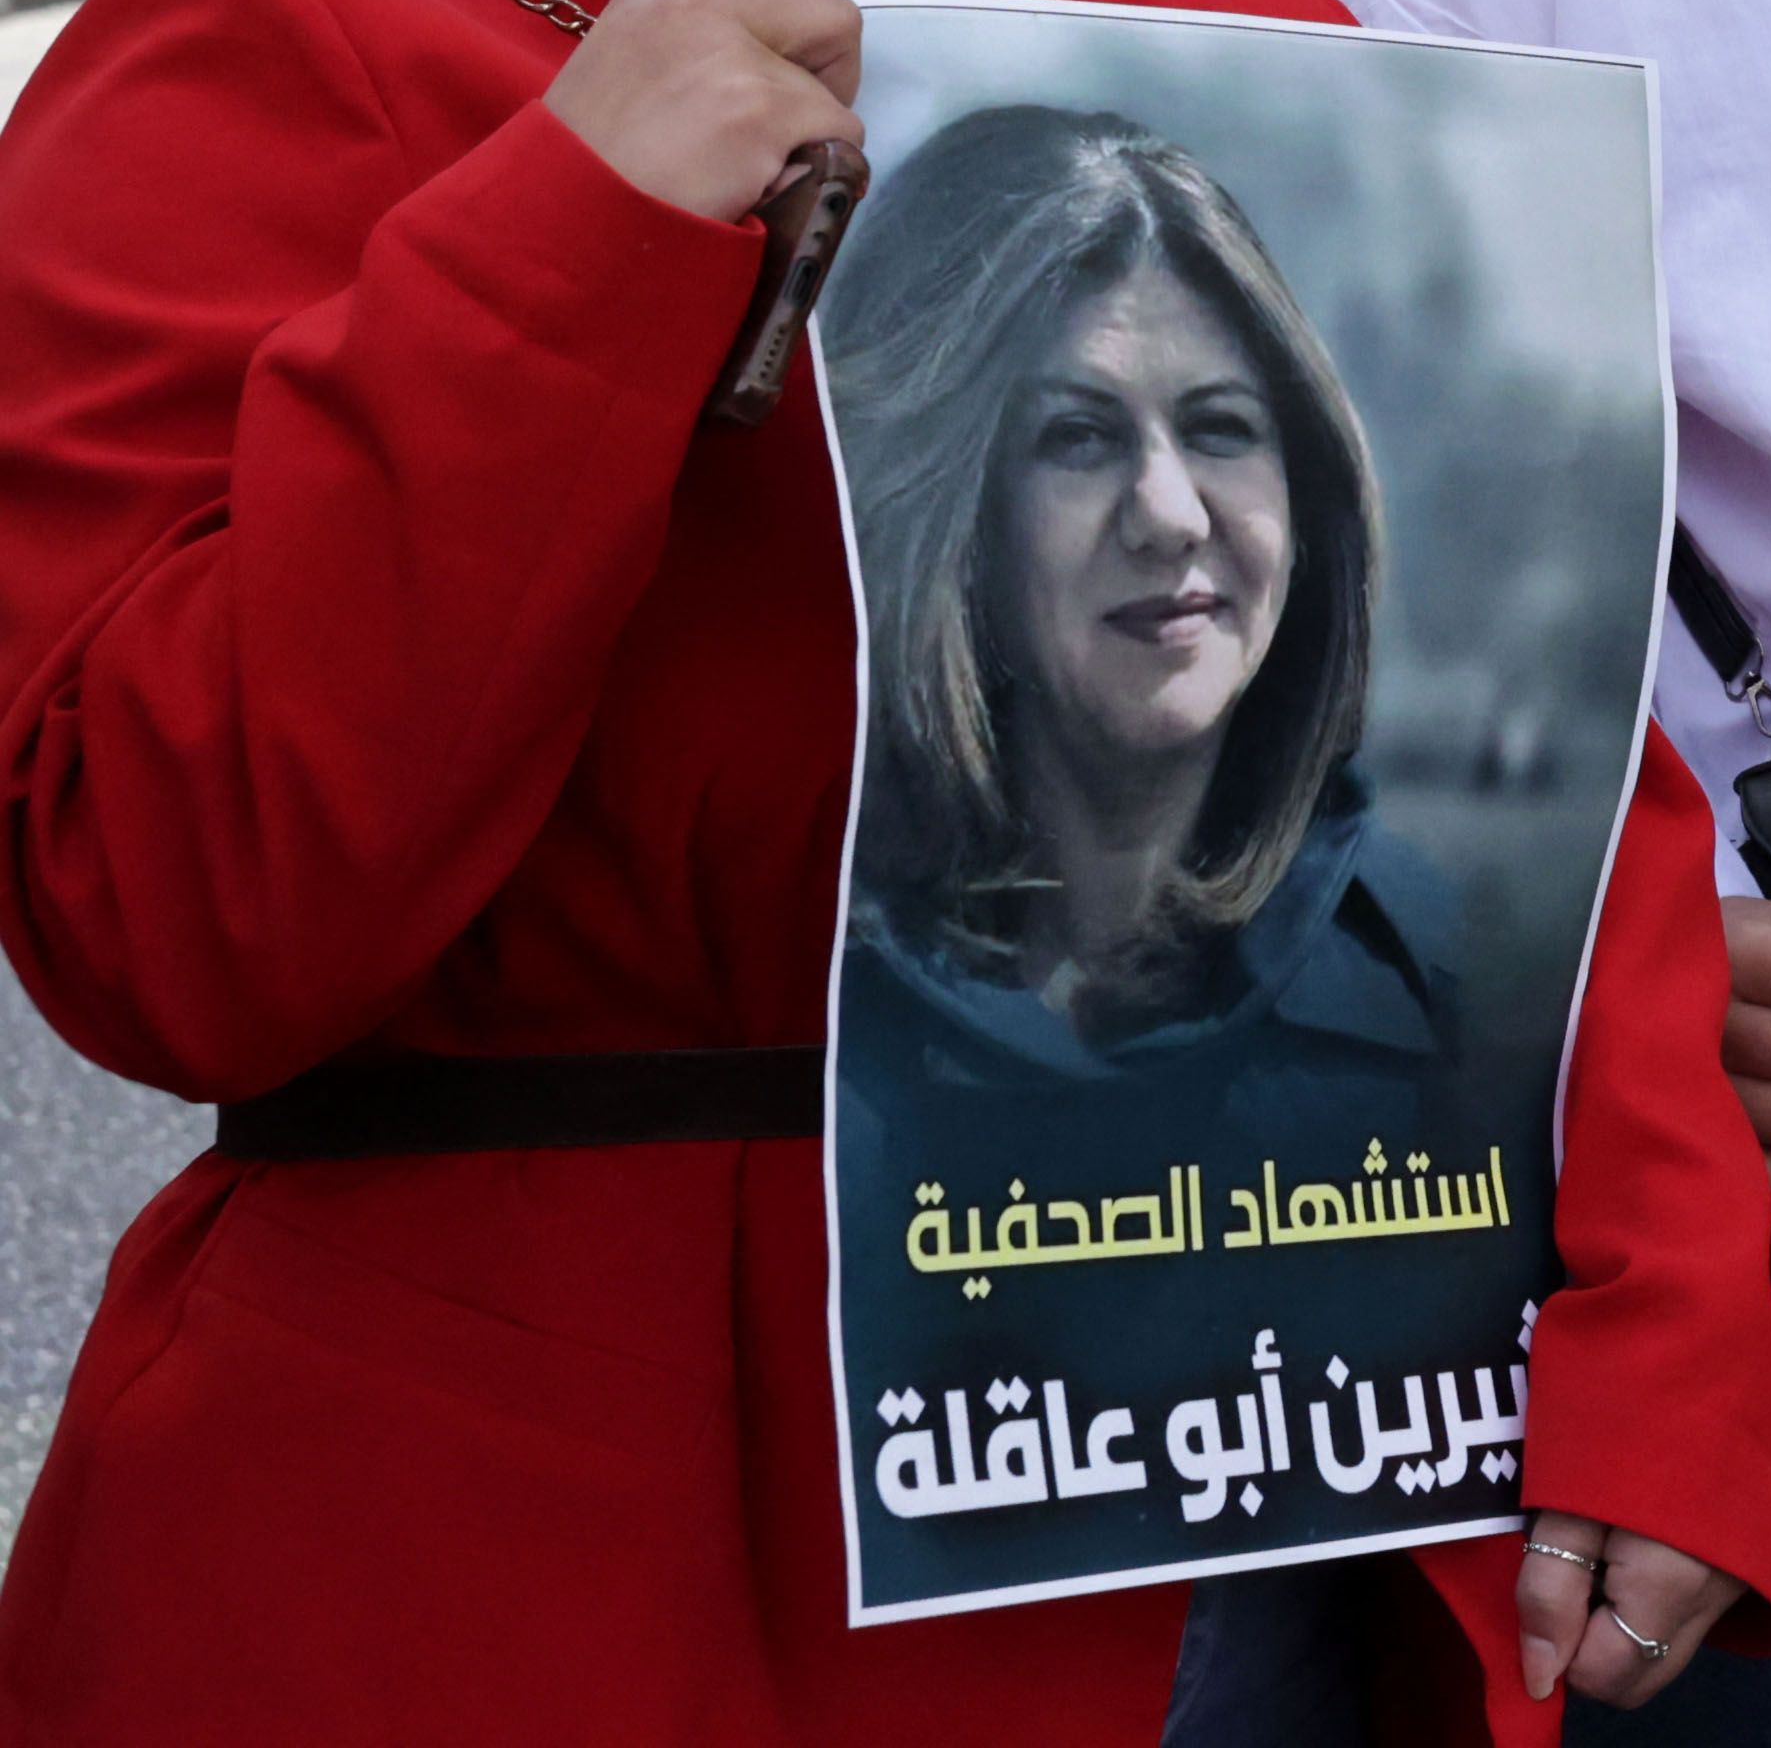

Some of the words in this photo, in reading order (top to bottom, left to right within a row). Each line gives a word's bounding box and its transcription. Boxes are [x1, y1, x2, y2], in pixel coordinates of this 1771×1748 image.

[906, 1164, 1205, 1301] الصحفية
[1223, 1137, 1511, 1248] استشهاد
[875, 1375, 1148, 1519] عاقلة
[1165, 1328, 1292, 1524] أبو
